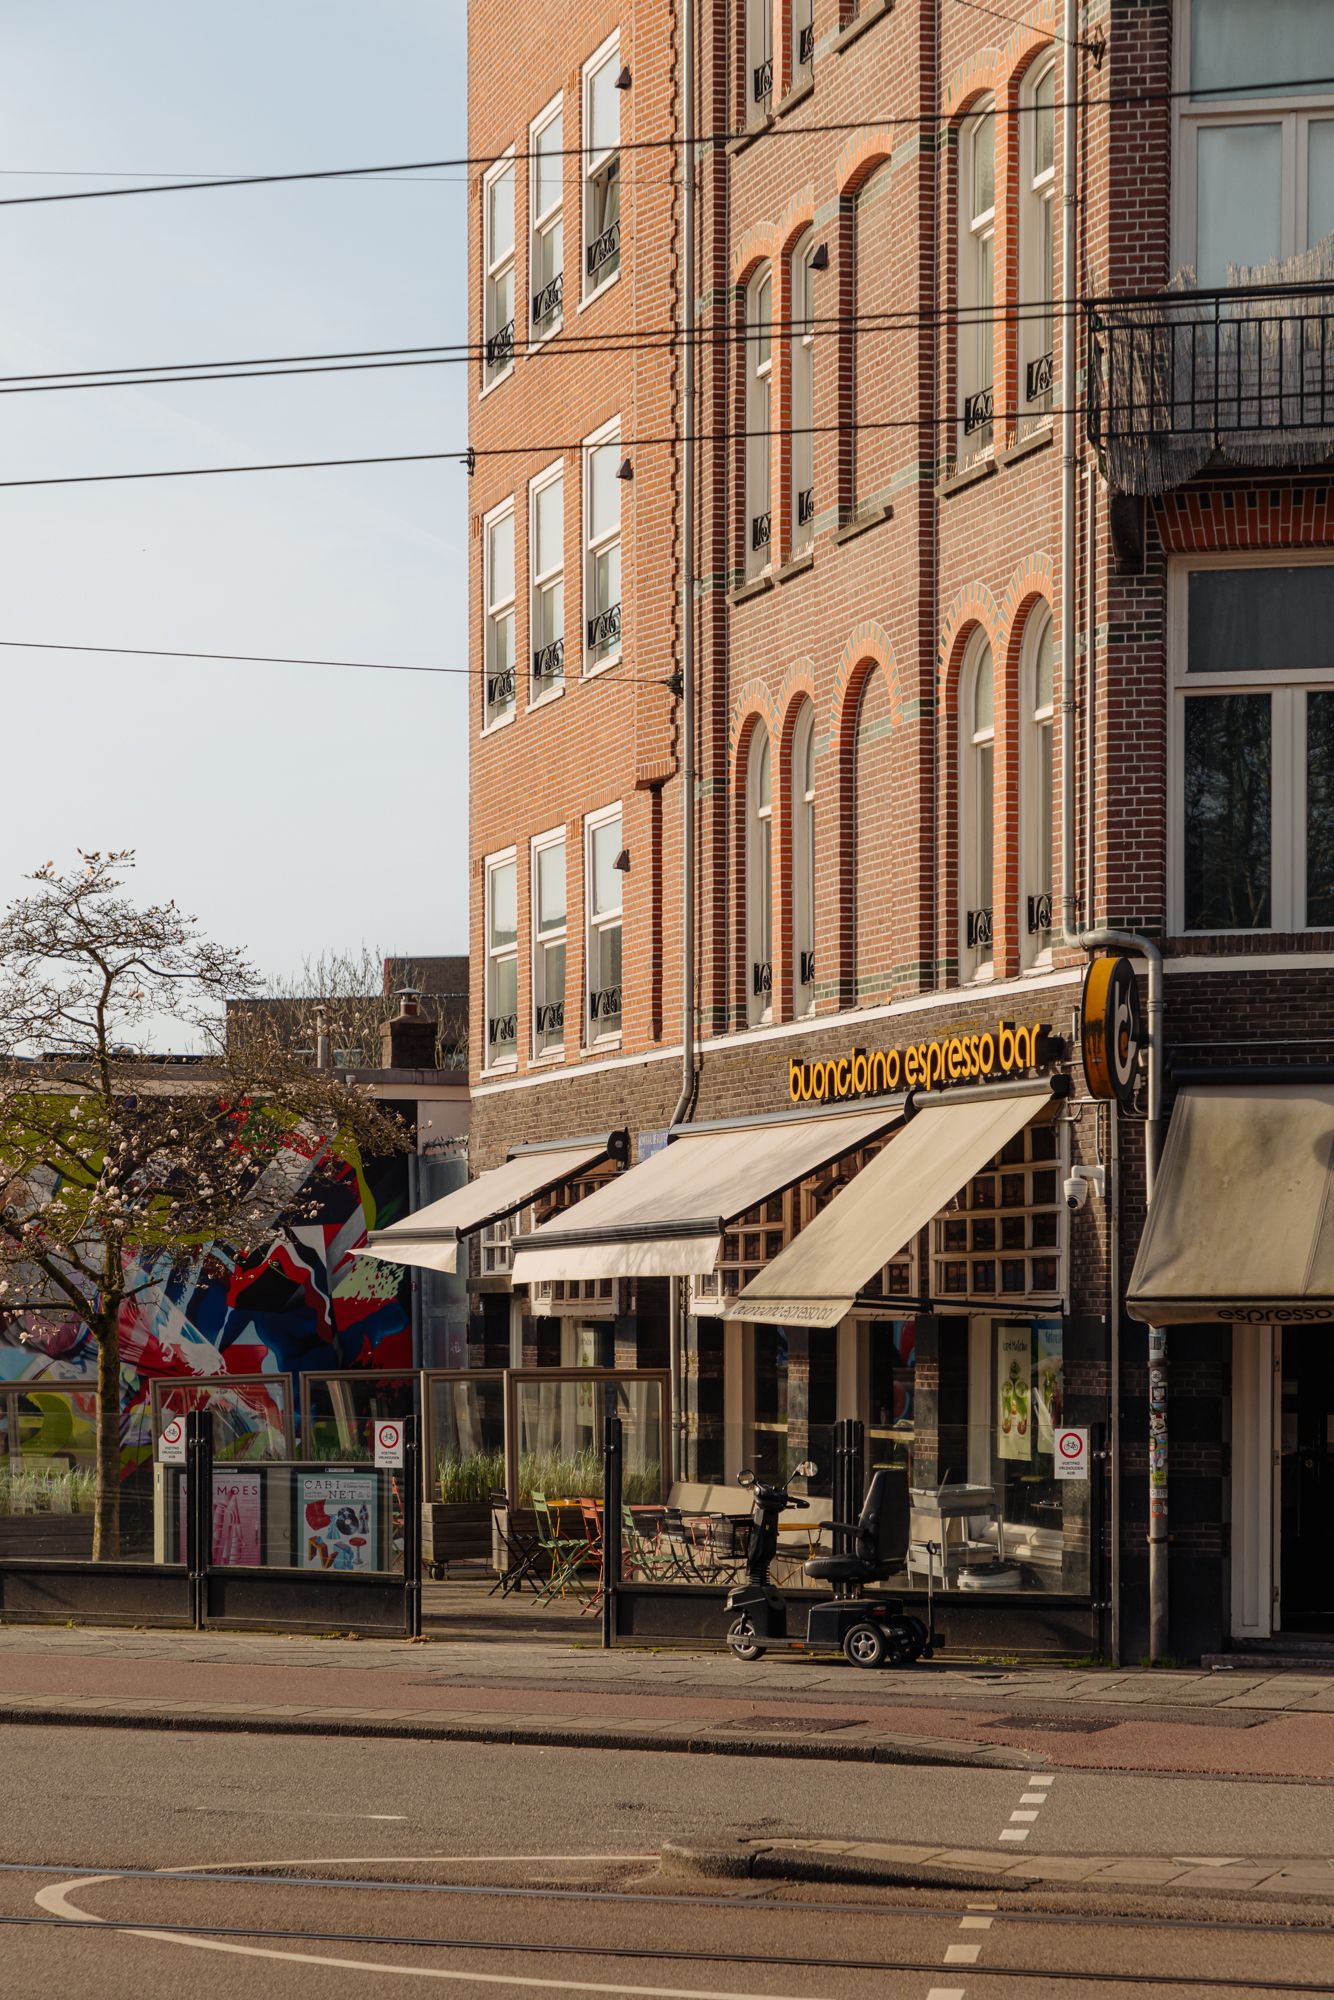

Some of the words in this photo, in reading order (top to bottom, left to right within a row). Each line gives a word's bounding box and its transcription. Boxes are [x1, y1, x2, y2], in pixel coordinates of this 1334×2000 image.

[789, 1046, 900, 1102] buongiorno
[905, 1032, 994, 1091] espresso
[999, 1020, 1040, 1072] bar
[1217, 1308, 1332, 1323] espresso
[304, 1480, 340, 1490] CABI
[328, 1490, 356, 1499] NET
